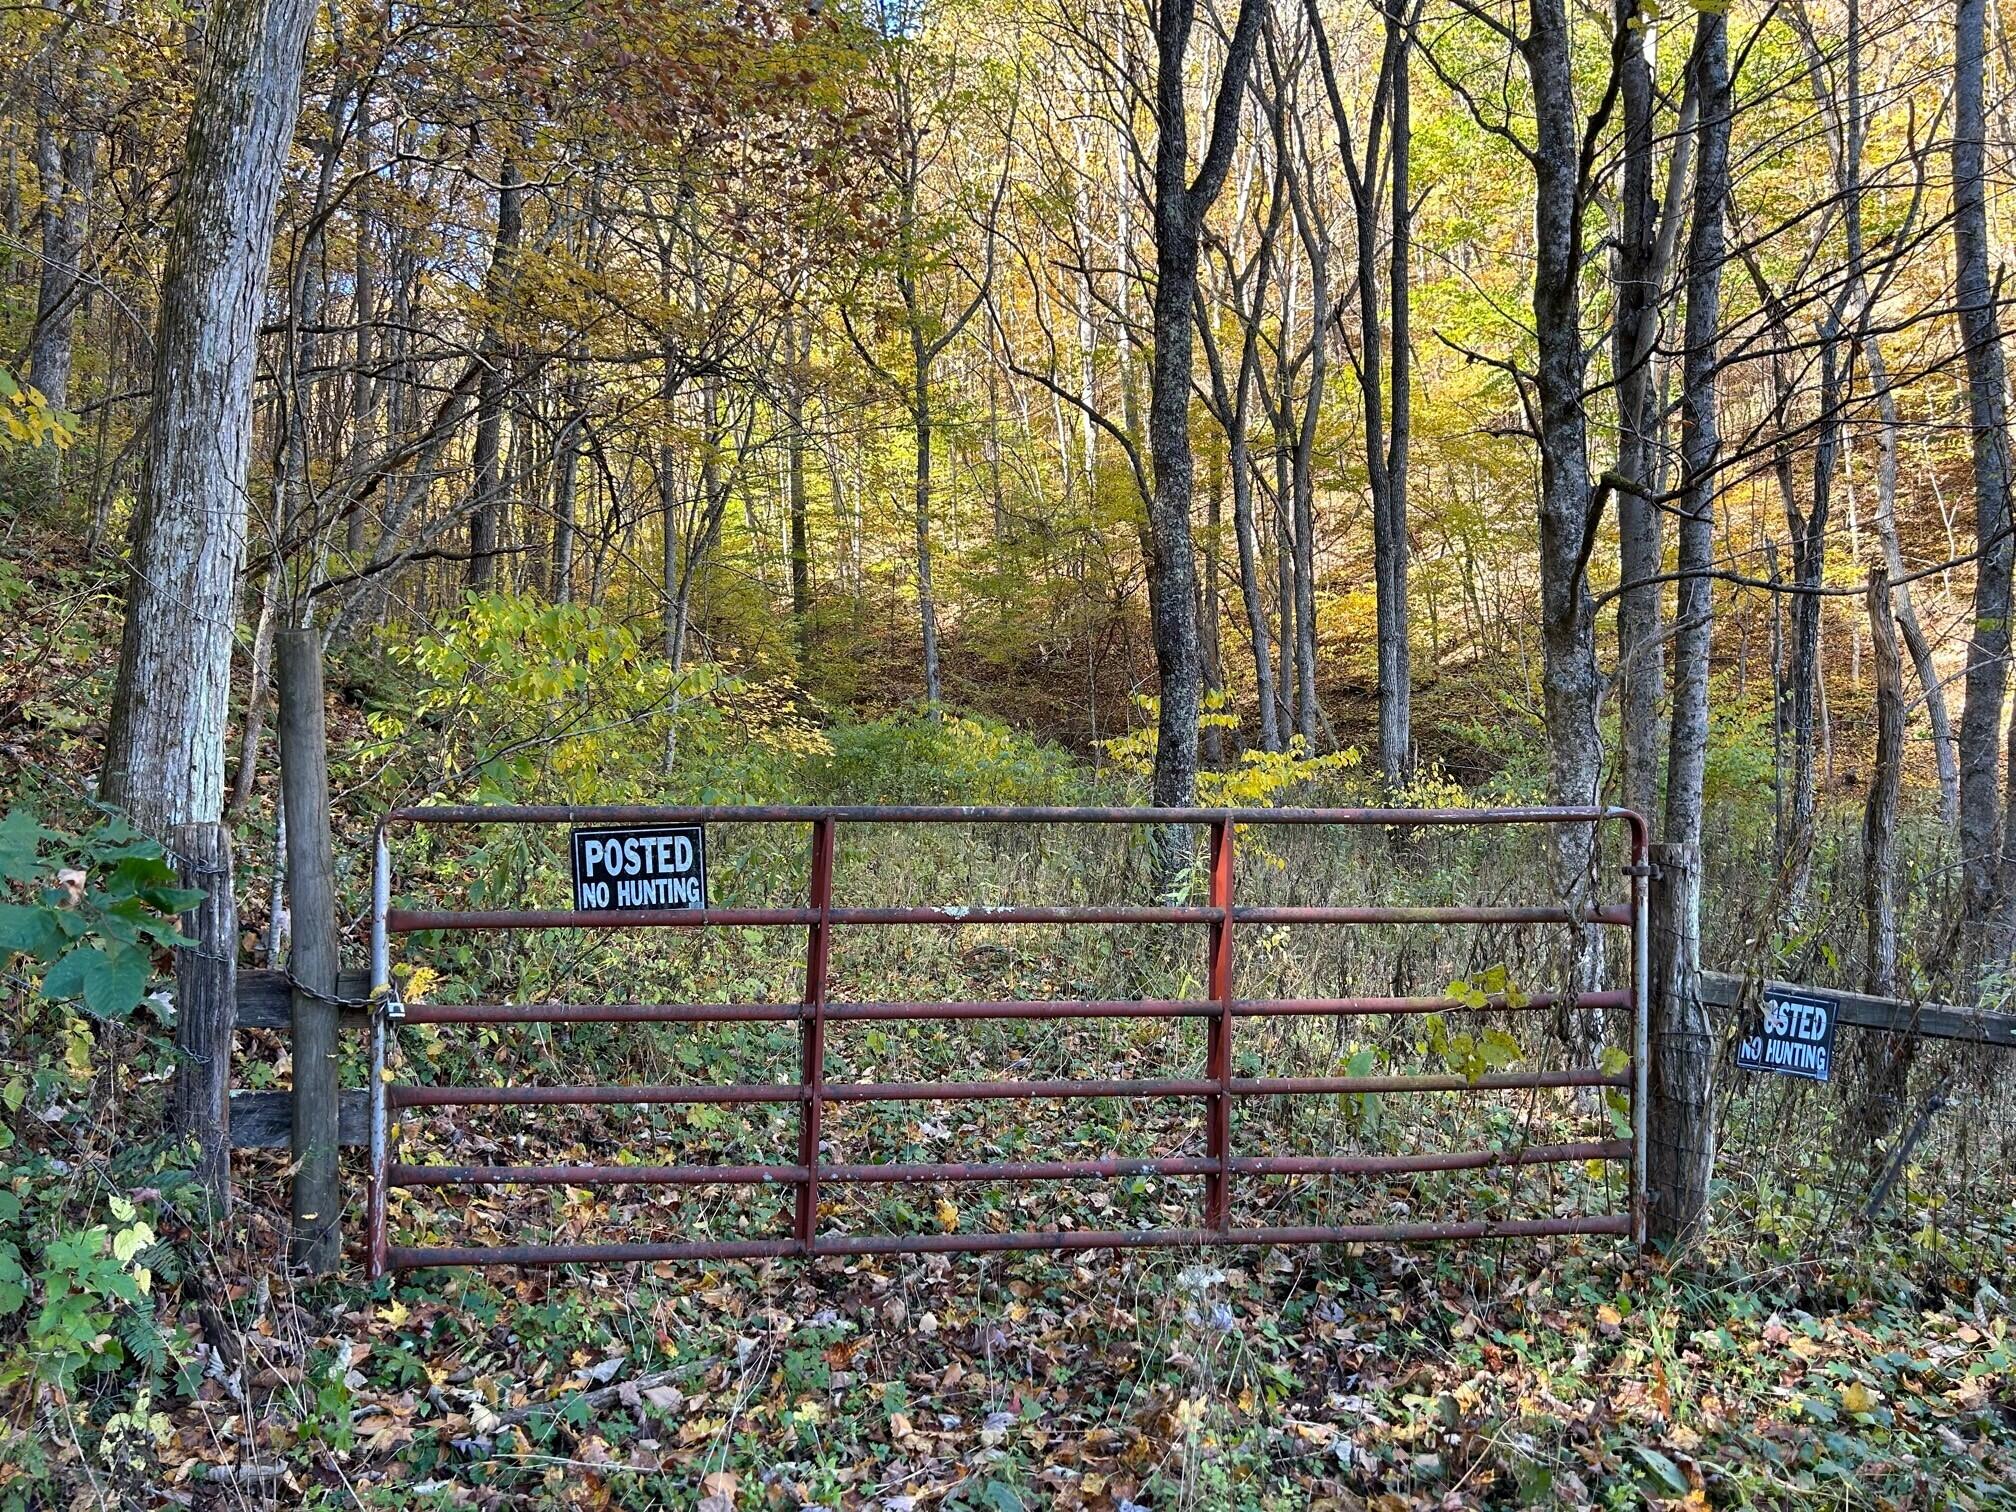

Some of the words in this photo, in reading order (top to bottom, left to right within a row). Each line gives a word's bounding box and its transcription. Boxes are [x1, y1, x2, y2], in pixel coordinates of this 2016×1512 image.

[585, 835, 693, 877] POSTED
[582, 881, 610, 908] NO
[616, 876, 700, 907] HUNTING
[1764, 1038, 1826, 1071] HUNTING
